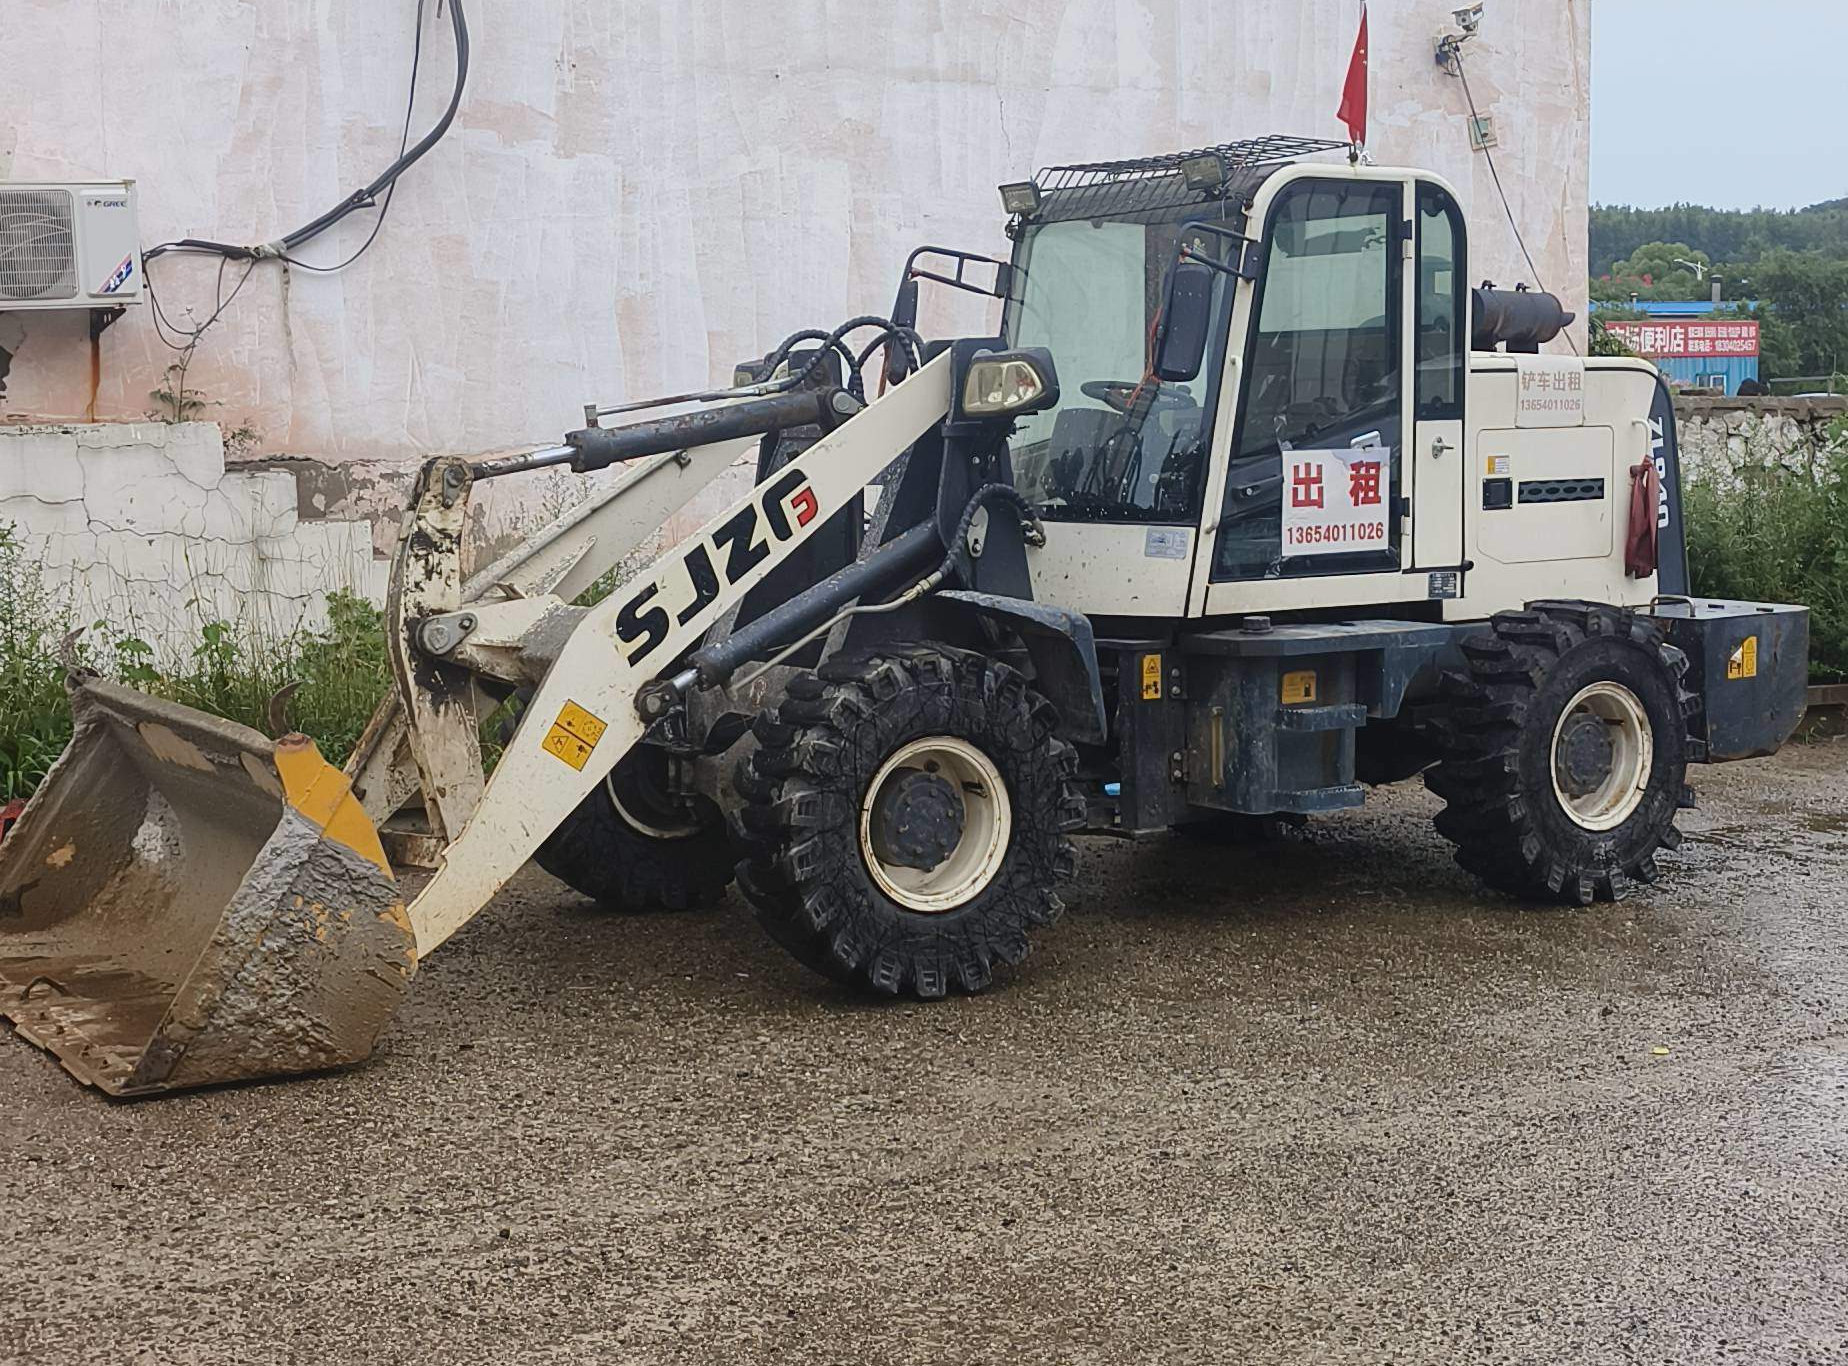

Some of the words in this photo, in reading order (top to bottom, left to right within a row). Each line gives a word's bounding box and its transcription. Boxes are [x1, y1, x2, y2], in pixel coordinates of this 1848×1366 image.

[1521, 371, 1581, 391] 铲车出租
[1521, 399, 1580, 411] 13654011026
[1292, 460, 1382, 508] 出租
[1287, 522, 1384, 544] 13654011026
